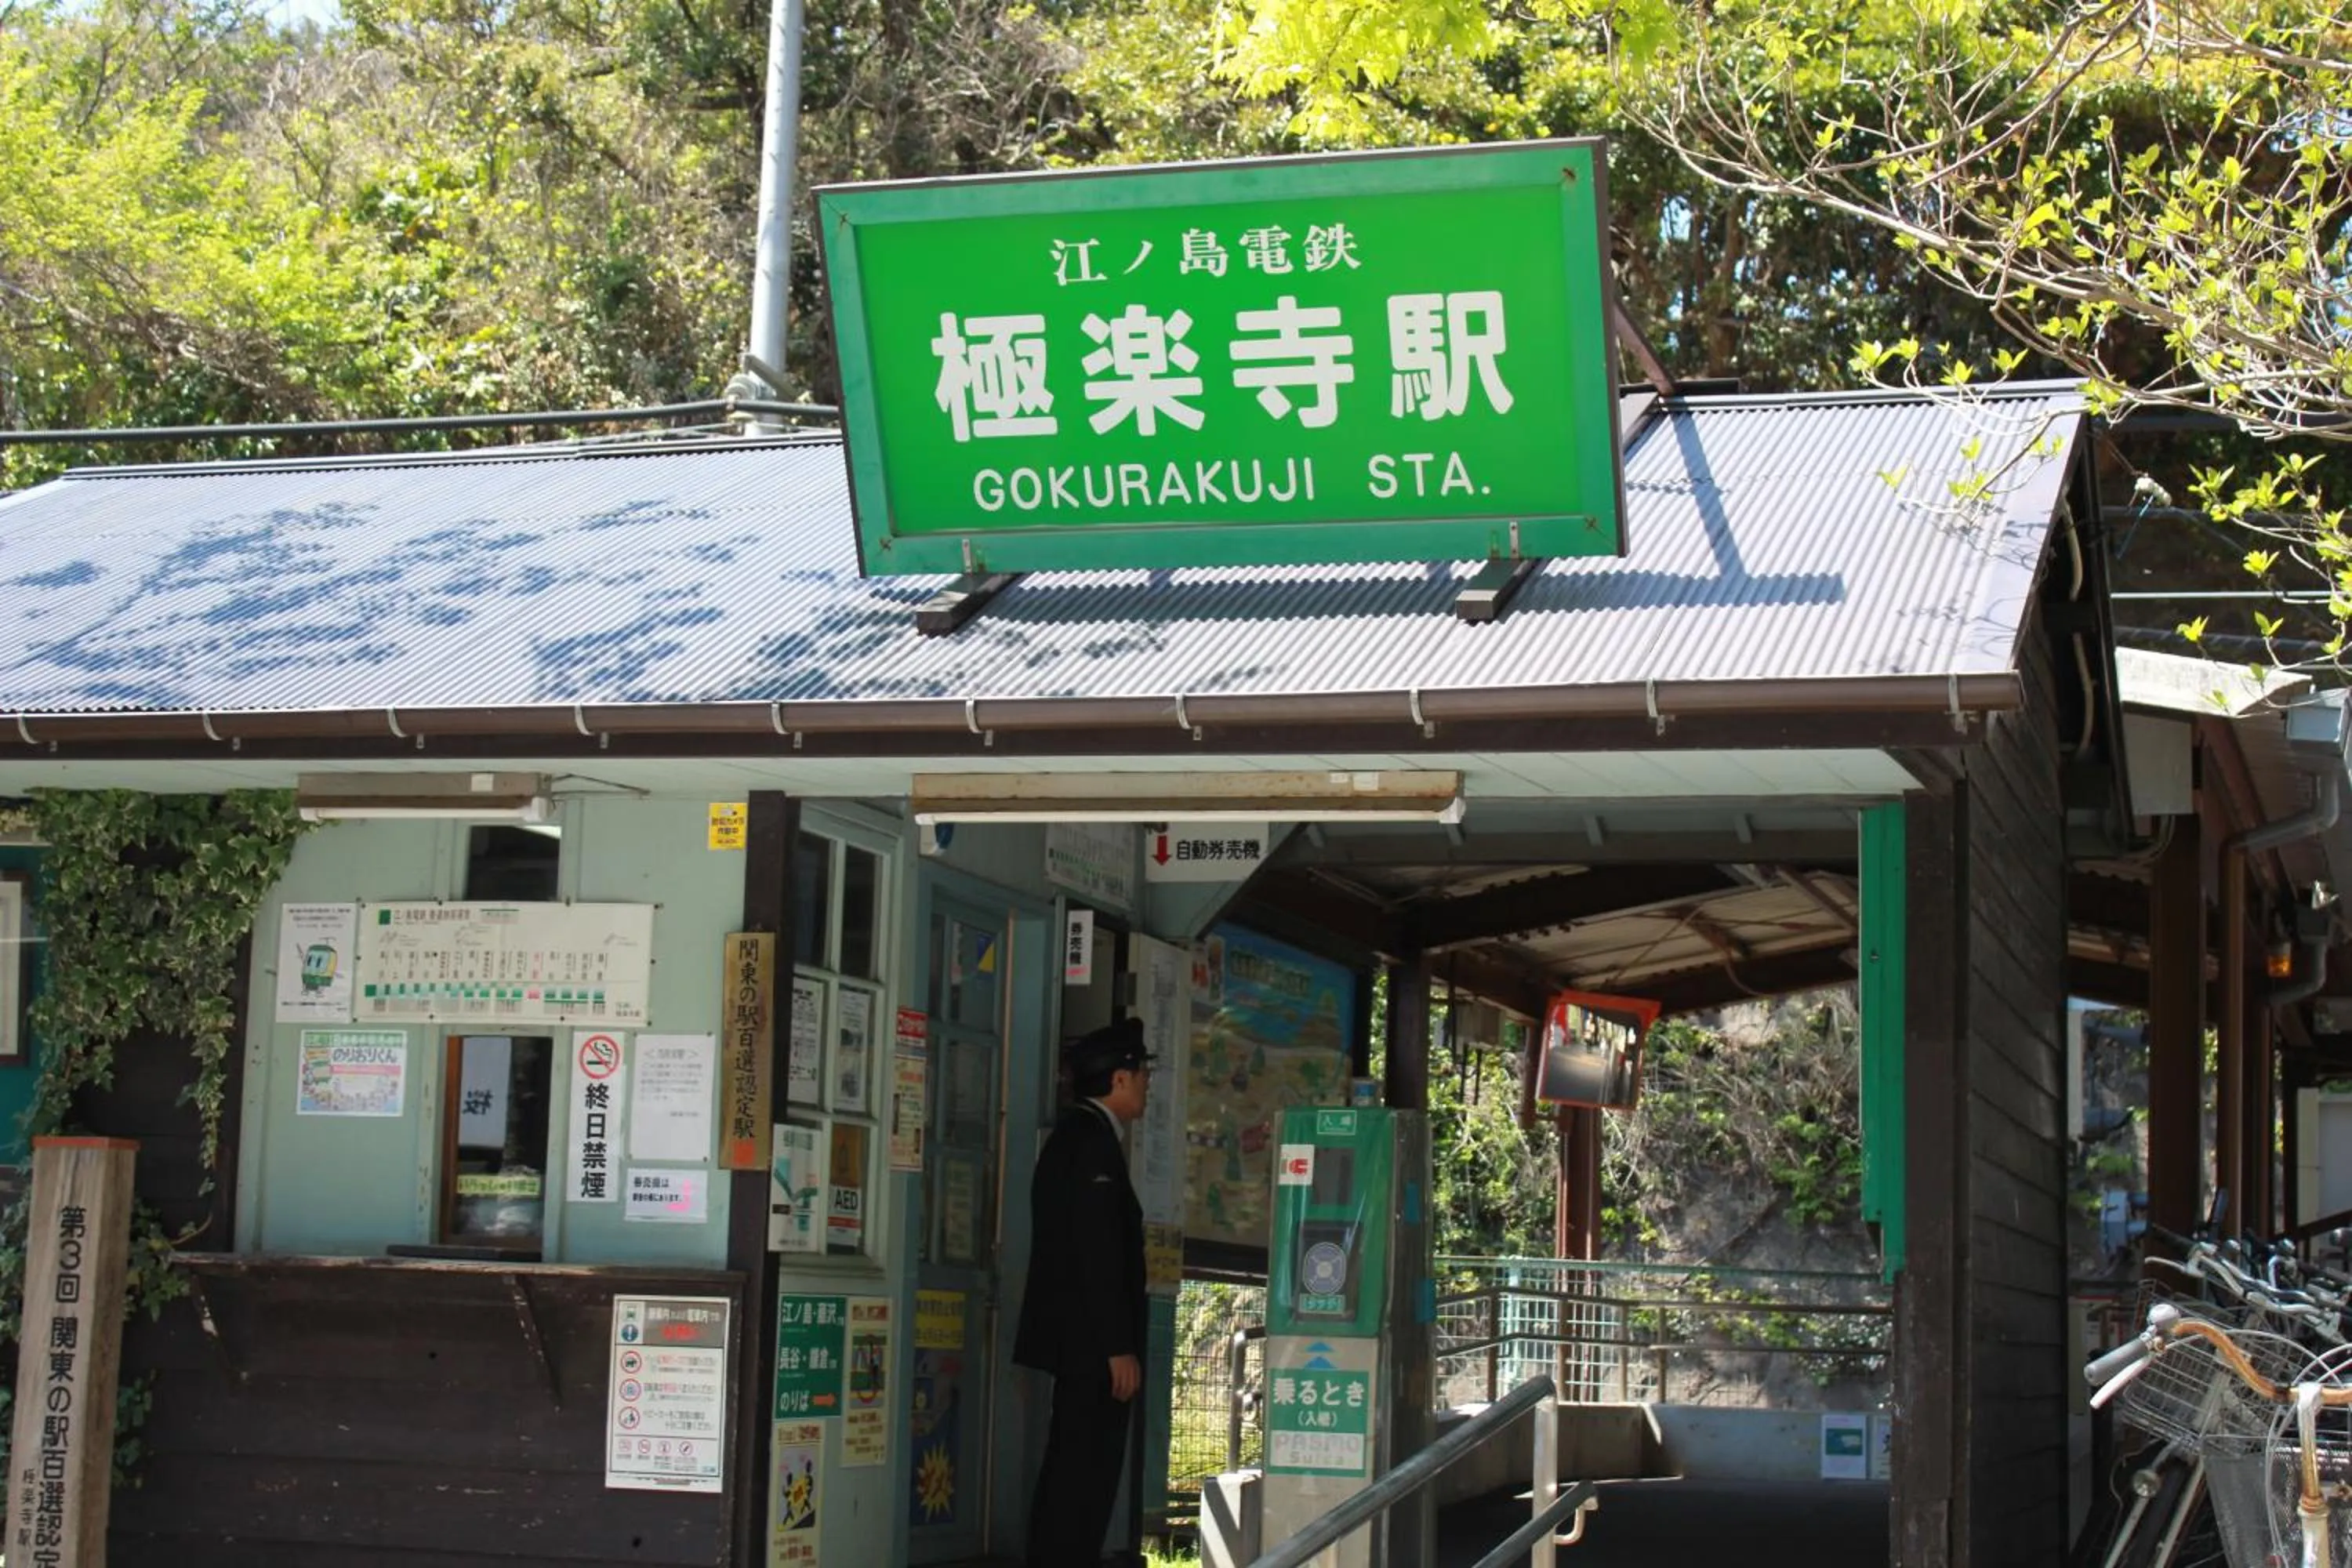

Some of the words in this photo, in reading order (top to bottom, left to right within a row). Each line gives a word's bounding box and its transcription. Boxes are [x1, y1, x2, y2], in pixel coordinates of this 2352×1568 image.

[1050, 223, 1362, 286] 江ノ島電鉄
[931, 290, 1514, 443] 極楽寺駅
[973, 456, 1316, 512] GOKURAKUJI
[1367, 451, 1490, 499] STA.
[1176, 840, 1260, 860] 自動券売機
[734, 938, 759, 1138] 関東の駅百選認定駅
[581, 1083, 609, 1198] 終日禁煙
[835, 1189, 858, 1210] AED
[55, 1207, 87, 1303] 第3回
[780, 1390, 810, 1411] のりば
[1273, 1377, 1364, 1407] 乗るとき
[1276, 1433, 1359, 1453] PASMO
[1290, 1451, 1344, 1465] Suica
